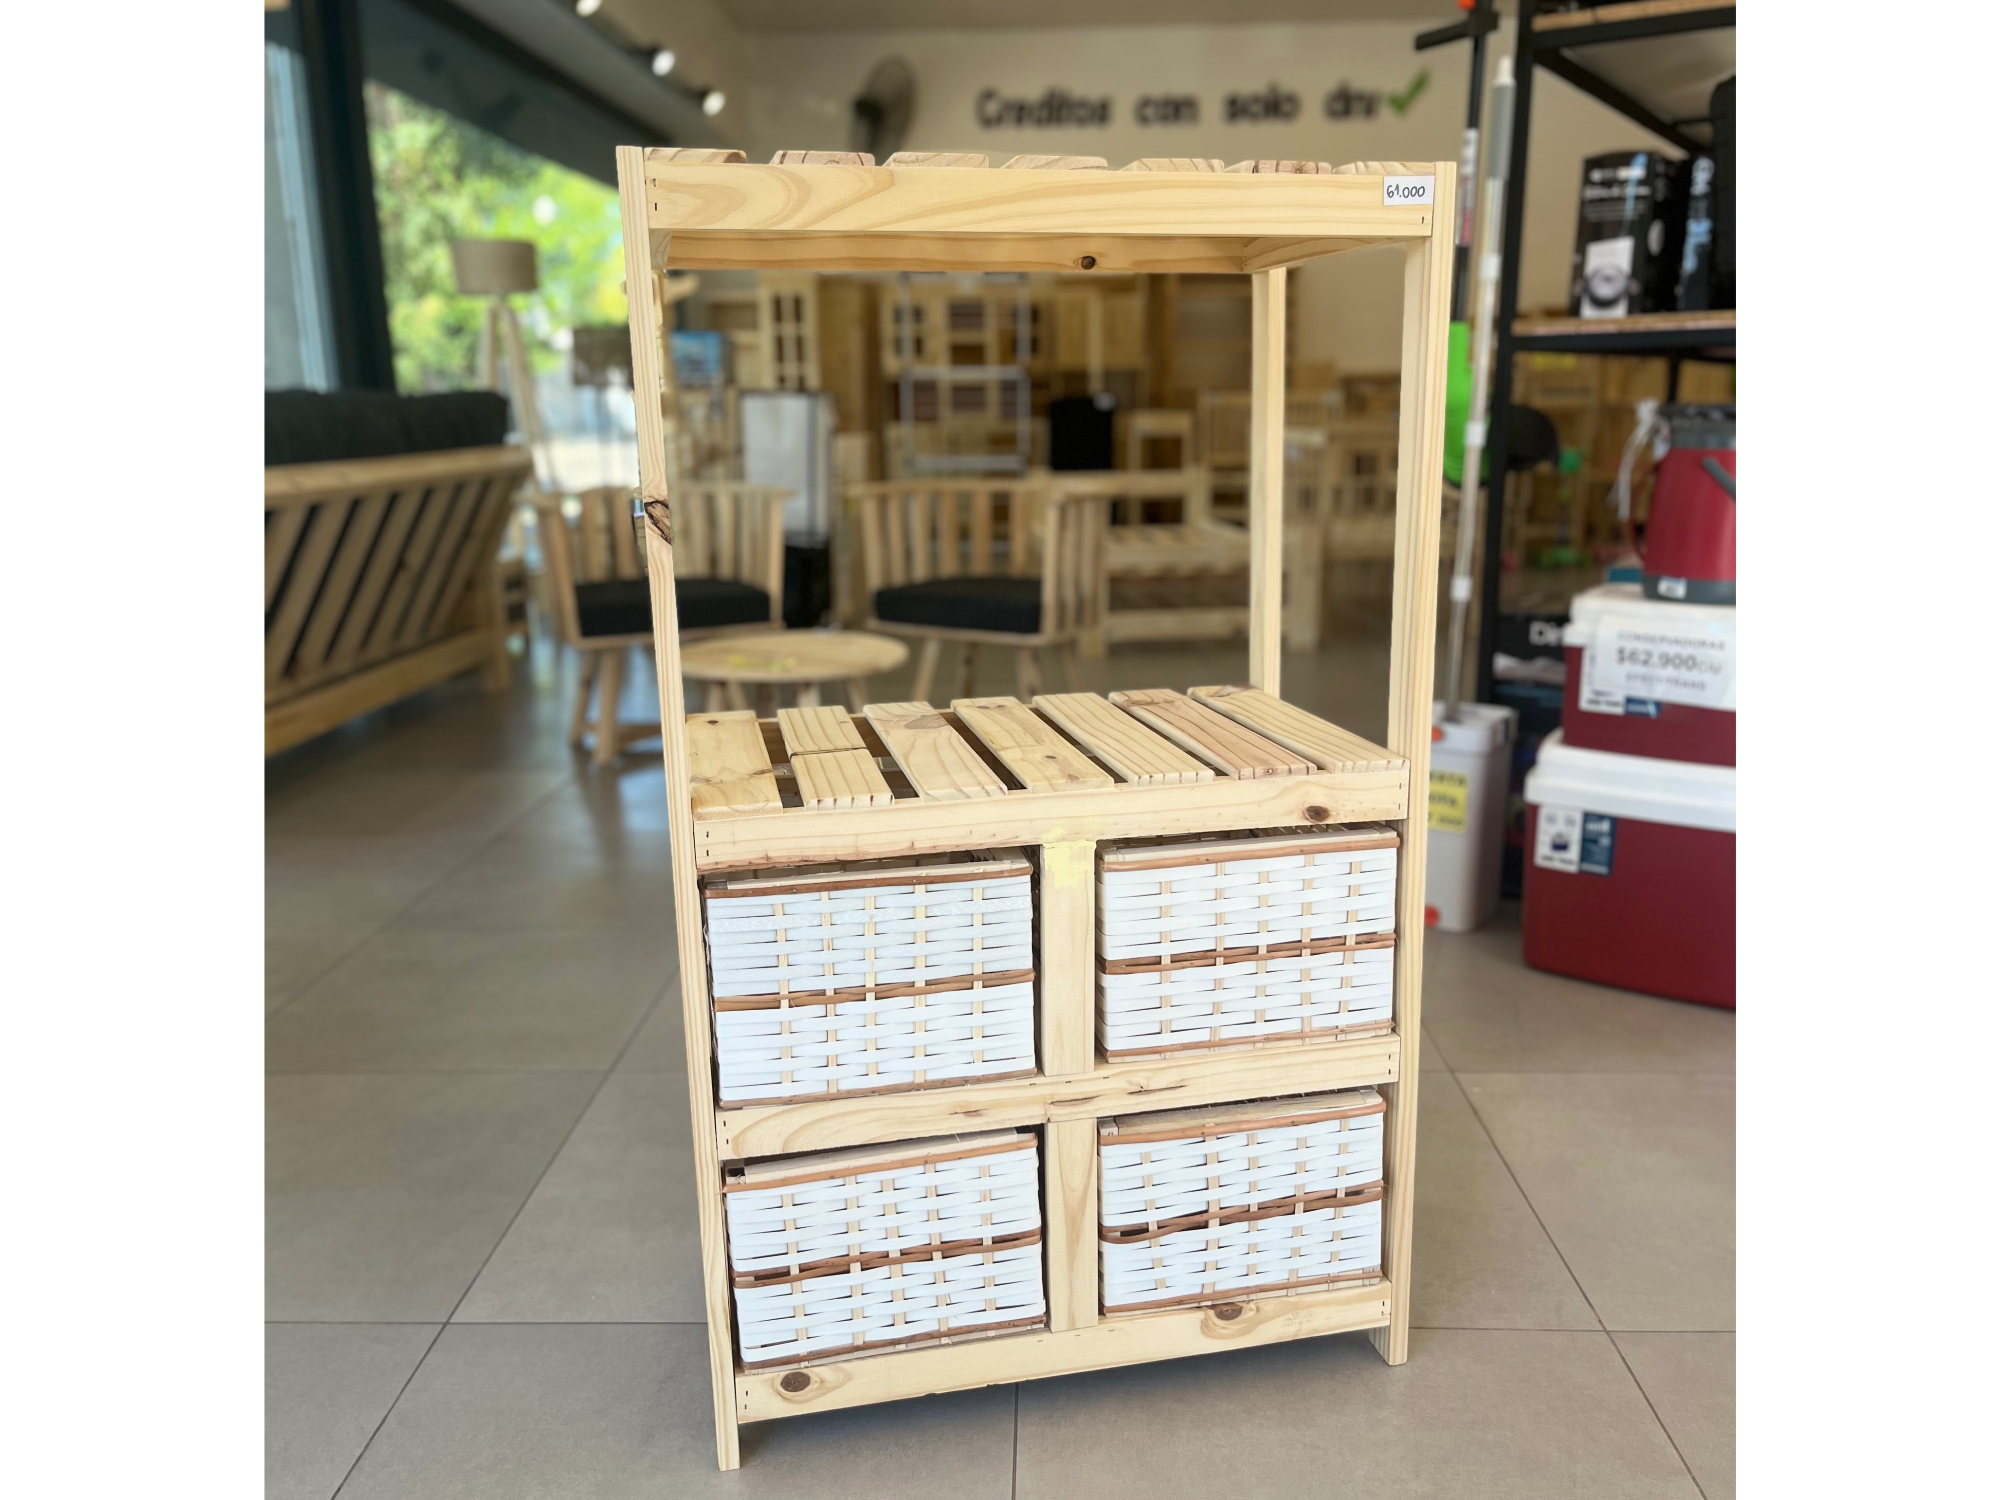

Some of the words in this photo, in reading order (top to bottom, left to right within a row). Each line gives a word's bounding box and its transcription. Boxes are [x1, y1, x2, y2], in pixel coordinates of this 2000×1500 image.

[1135, 94, 1199, 127] con
[1226, 85, 1299, 123] solo
[1386, 183, 1426, 199] 61.000
